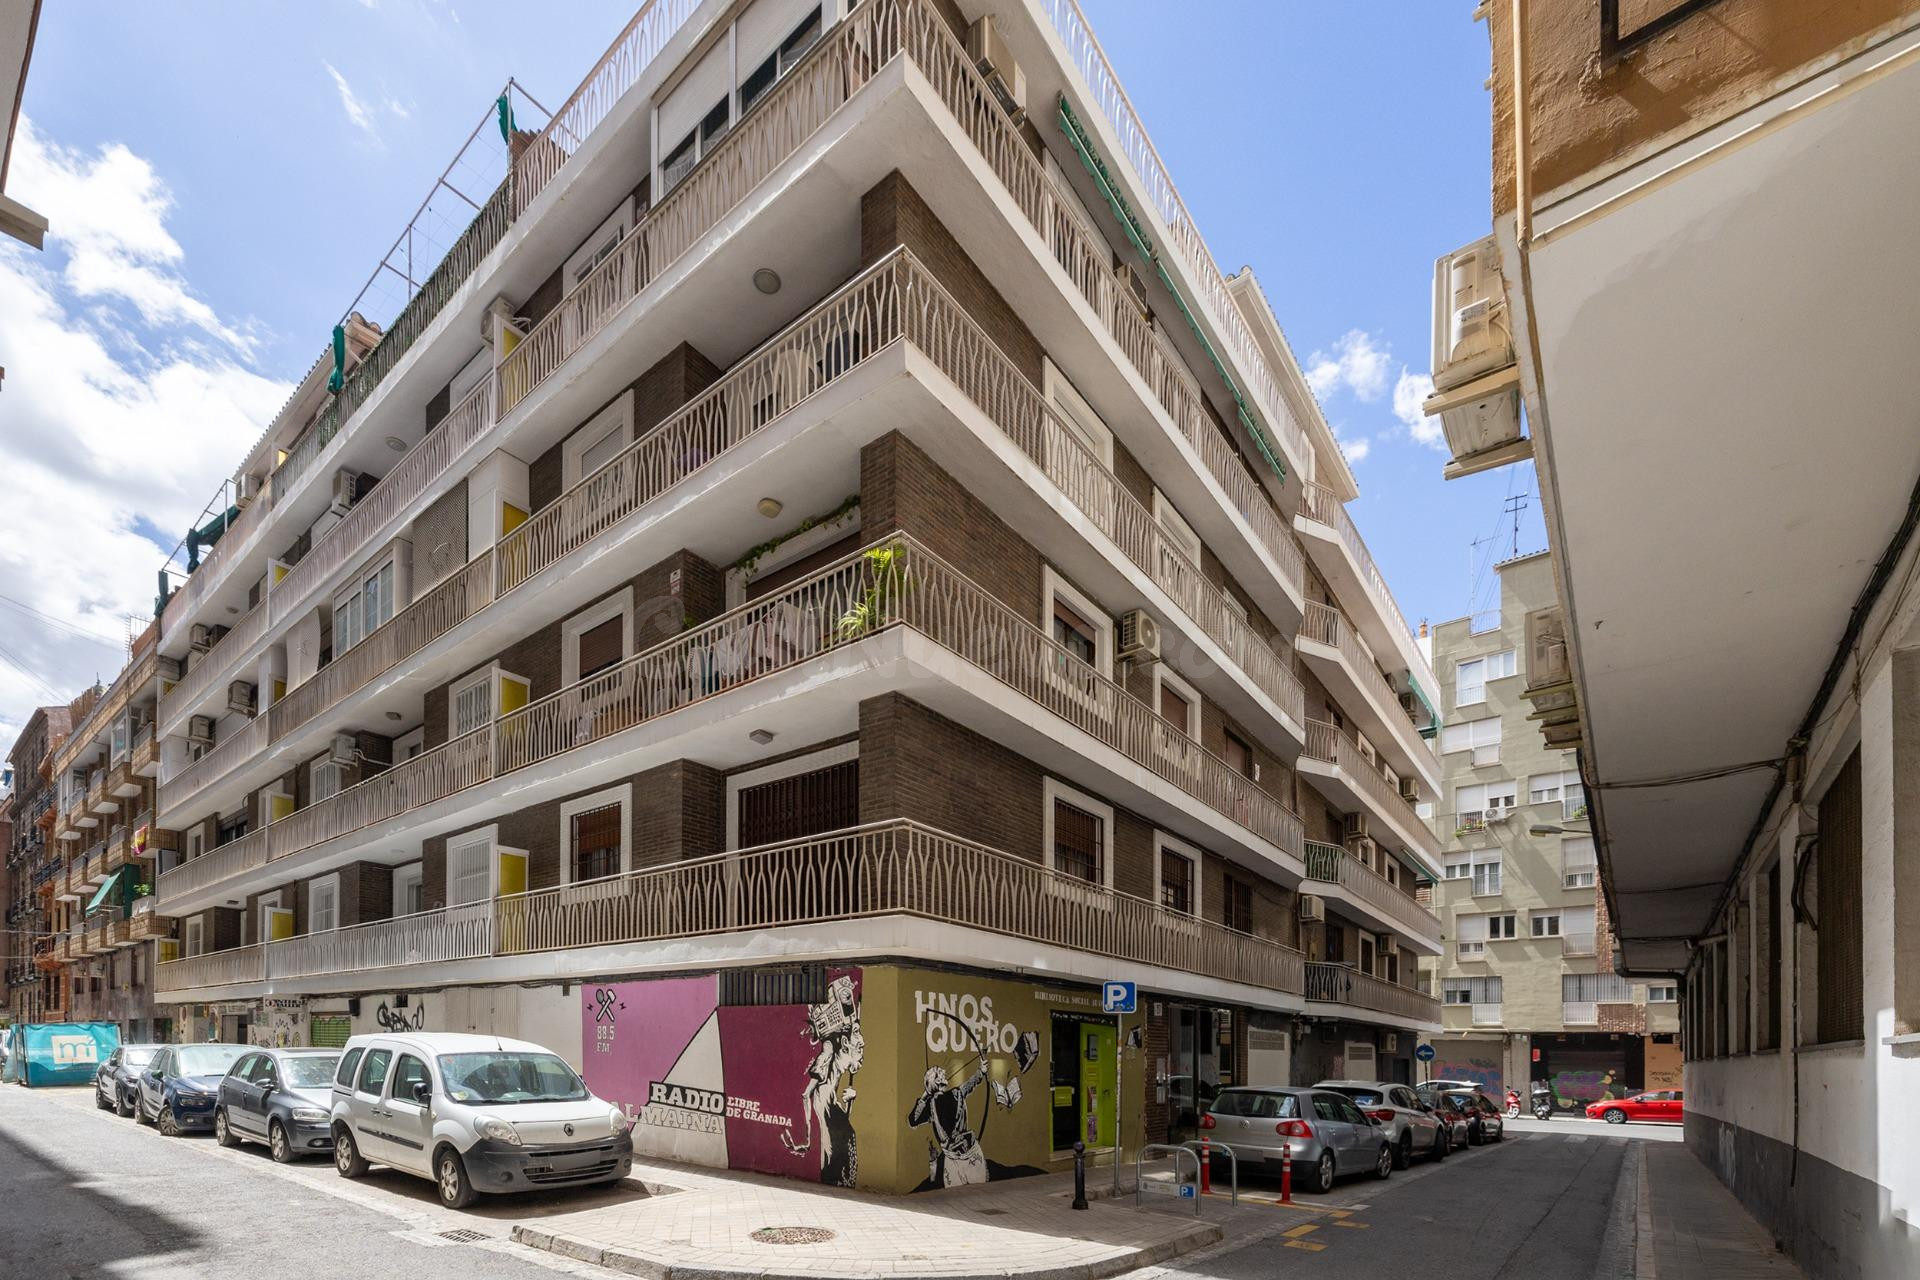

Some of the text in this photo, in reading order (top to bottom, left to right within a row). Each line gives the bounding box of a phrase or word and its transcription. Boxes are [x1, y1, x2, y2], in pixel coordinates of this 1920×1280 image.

[1107, 985, 1127, 1009] P
[926, 1022, 1018, 1053] QUERO
[650, 1083, 724, 1114] RADIO
[727, 1097, 760, 1112] LIBRE
[725, 1106, 793, 1127] DE GRANADA
